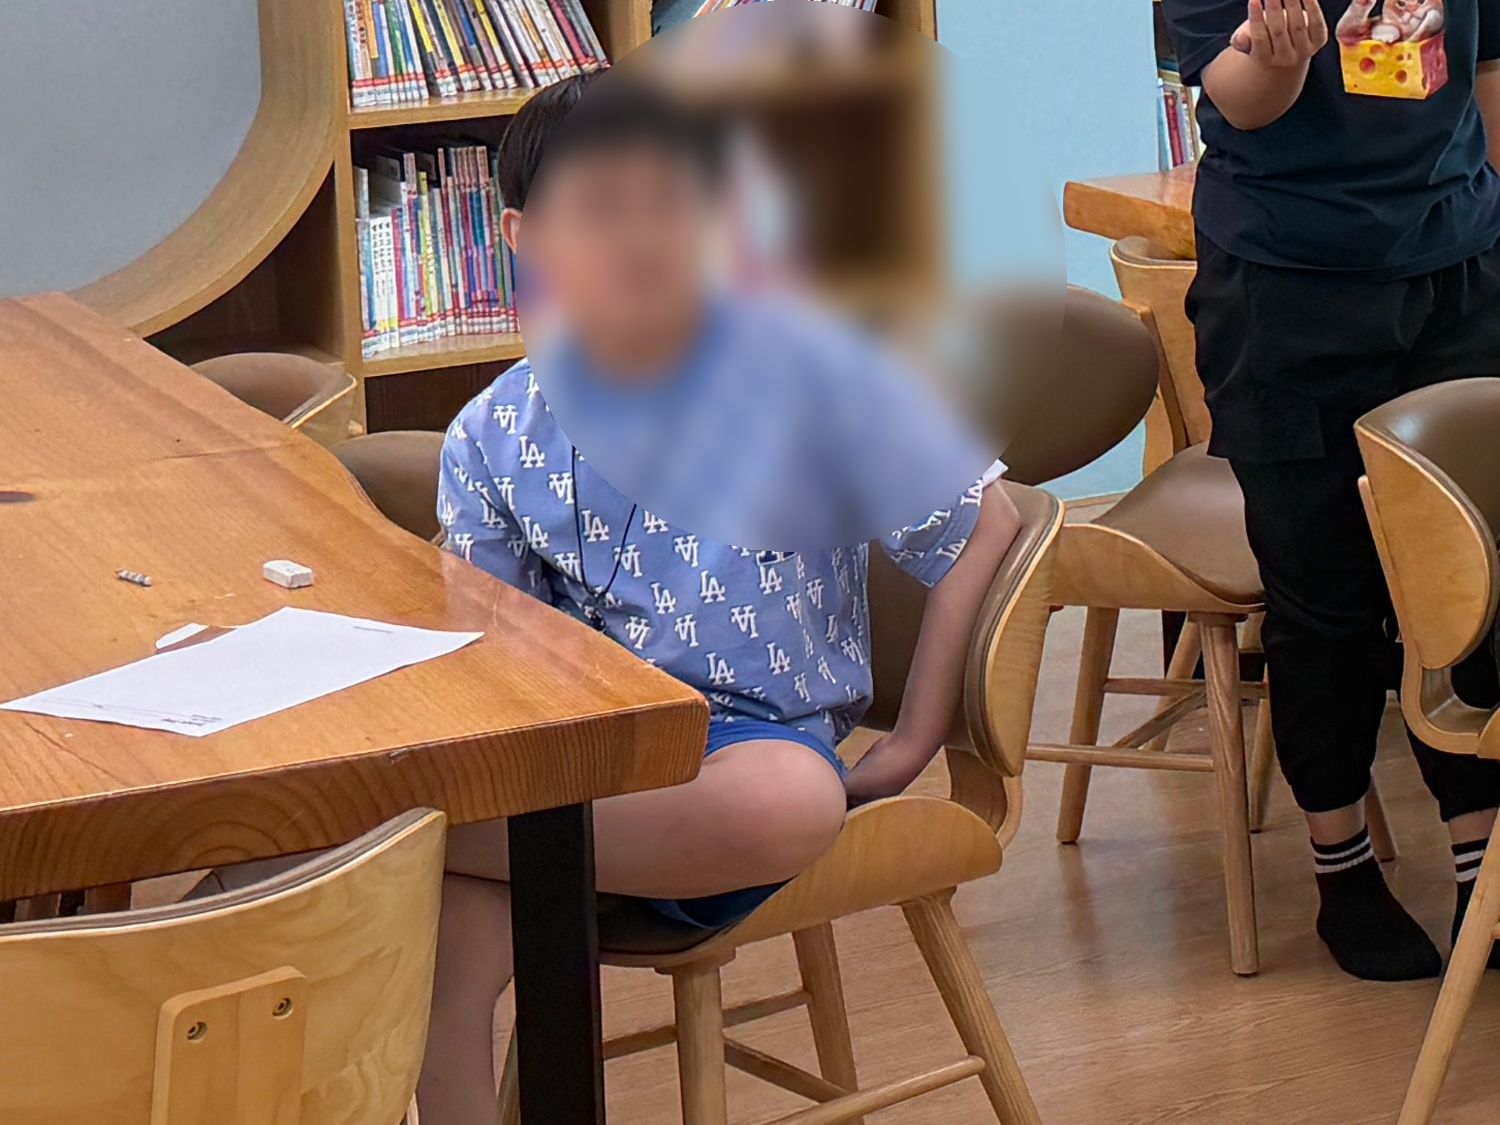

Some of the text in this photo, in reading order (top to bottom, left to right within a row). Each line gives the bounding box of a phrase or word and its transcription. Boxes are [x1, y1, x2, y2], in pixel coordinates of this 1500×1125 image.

[493, 405, 518, 434] LA
[519, 435, 546, 468] LA
[549, 472, 575, 504] LA
[522, 516, 549, 549] LA
[582, 510, 609, 543] LA
[613, 544, 643, 577] LA
[674, 535, 699, 568] LA
[700, 570, 727, 603] LA
[760, 564, 783, 595] LA
[807, 578, 825, 610] LA
[651, 582, 677, 615] LA
[625, 616, 651, 650] LA
[675, 613, 699, 648] LA
[731, 605, 760, 639] LA
[706, 652, 736, 686] LA
[767, 642, 791, 675] LA
